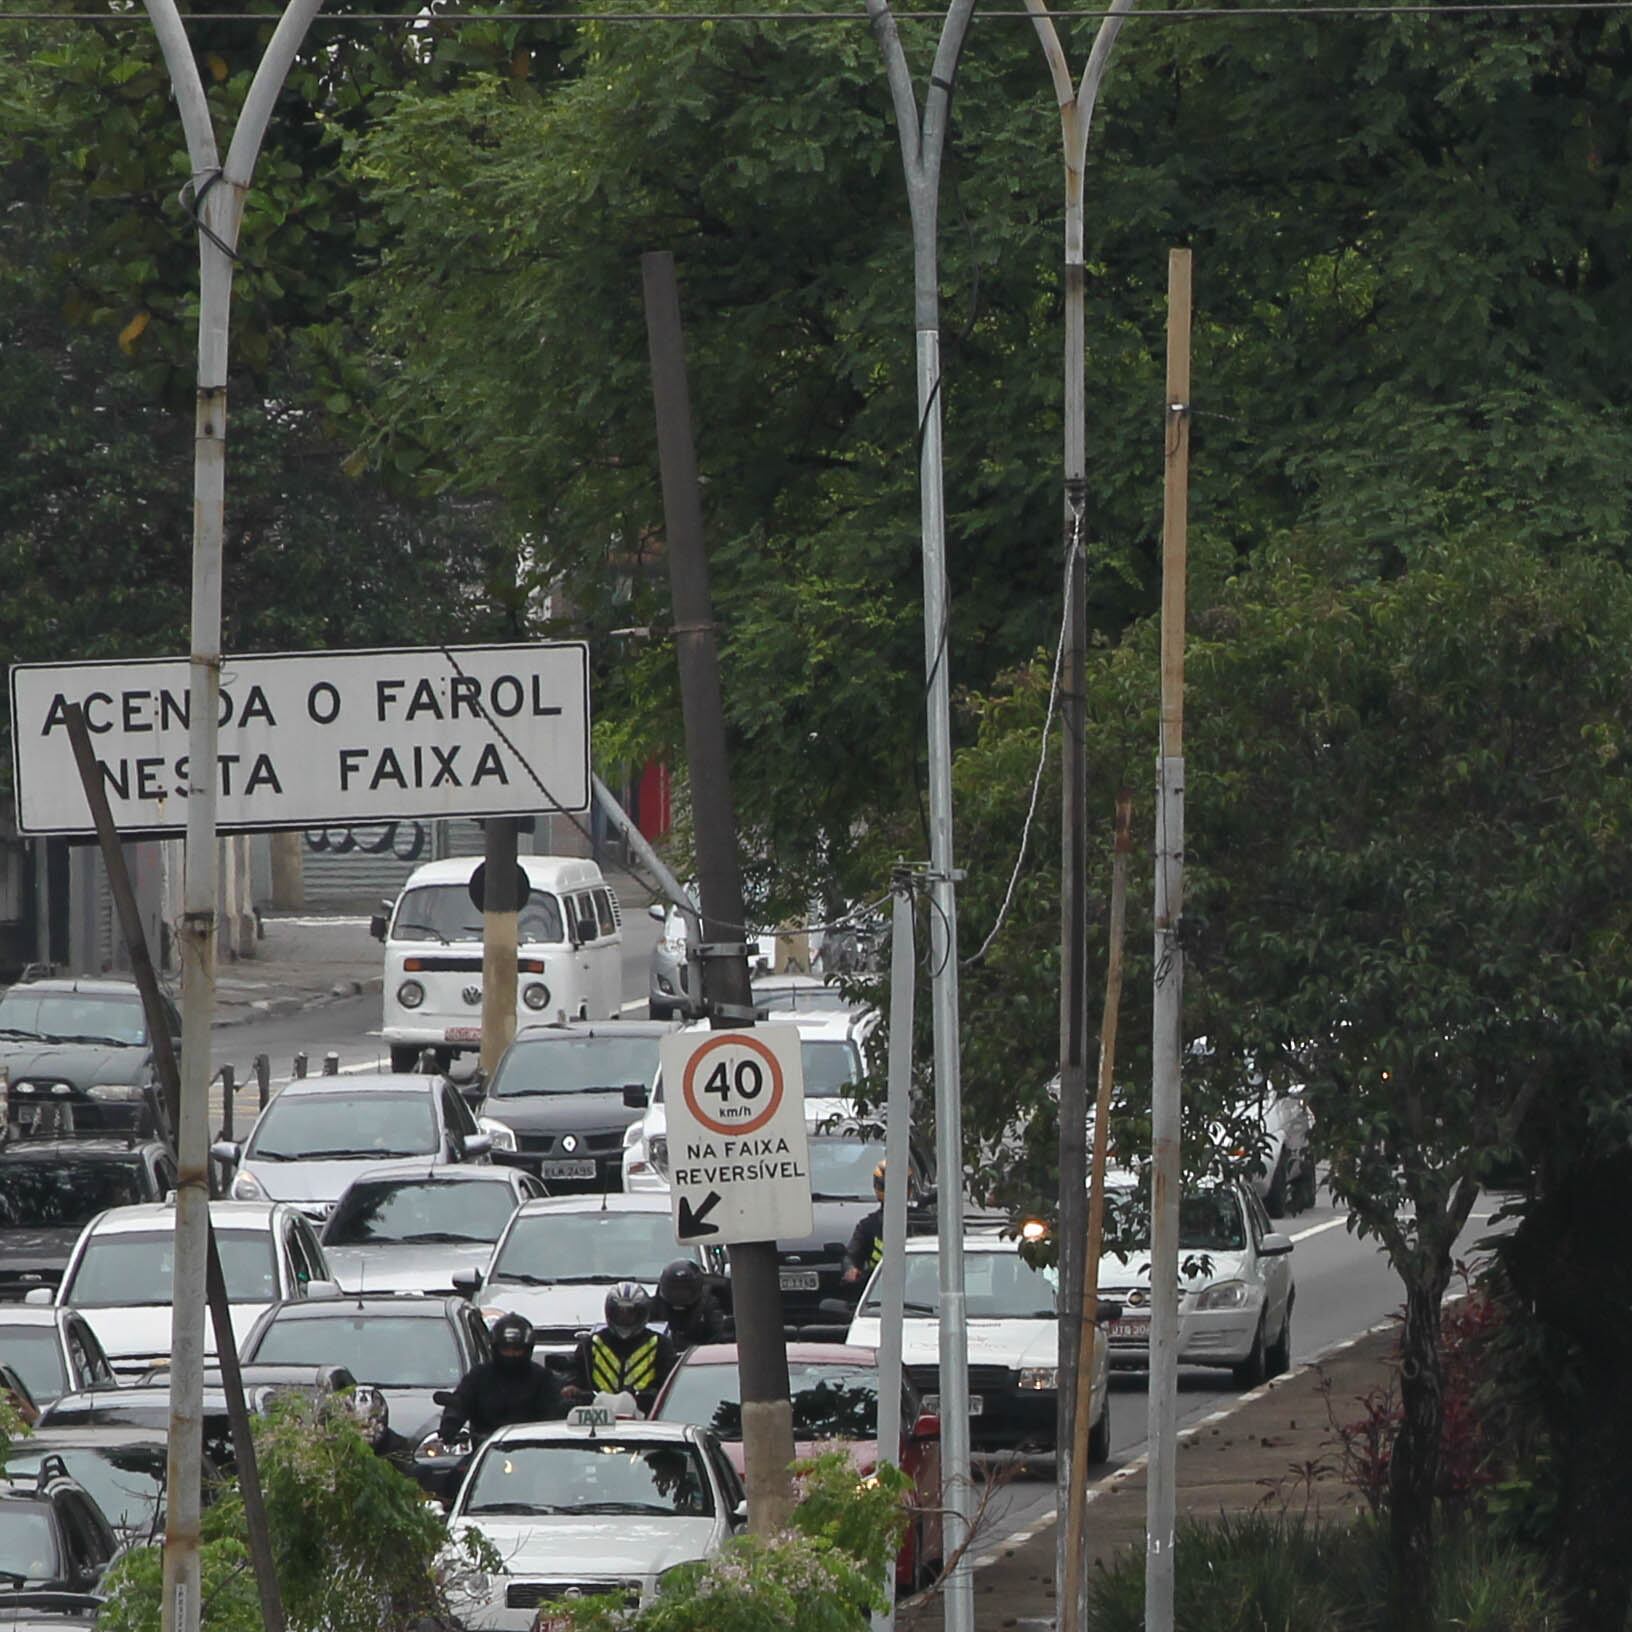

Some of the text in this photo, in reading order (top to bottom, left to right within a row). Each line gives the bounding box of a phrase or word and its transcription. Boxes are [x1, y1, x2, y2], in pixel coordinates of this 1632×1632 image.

[307, 681, 341, 725] O
[377, 673, 563, 722] FAROL
[339, 742, 510, 791] FAIXA
[704, 1060, 763, 1101] 40
[720, 1106, 751, 1117] km/h
[687, 1138, 789, 1159] NA FAIXA
[675, 1160, 805, 1185] REVERSÍVEL
[576, 1409, 609, 1425] TAXI
